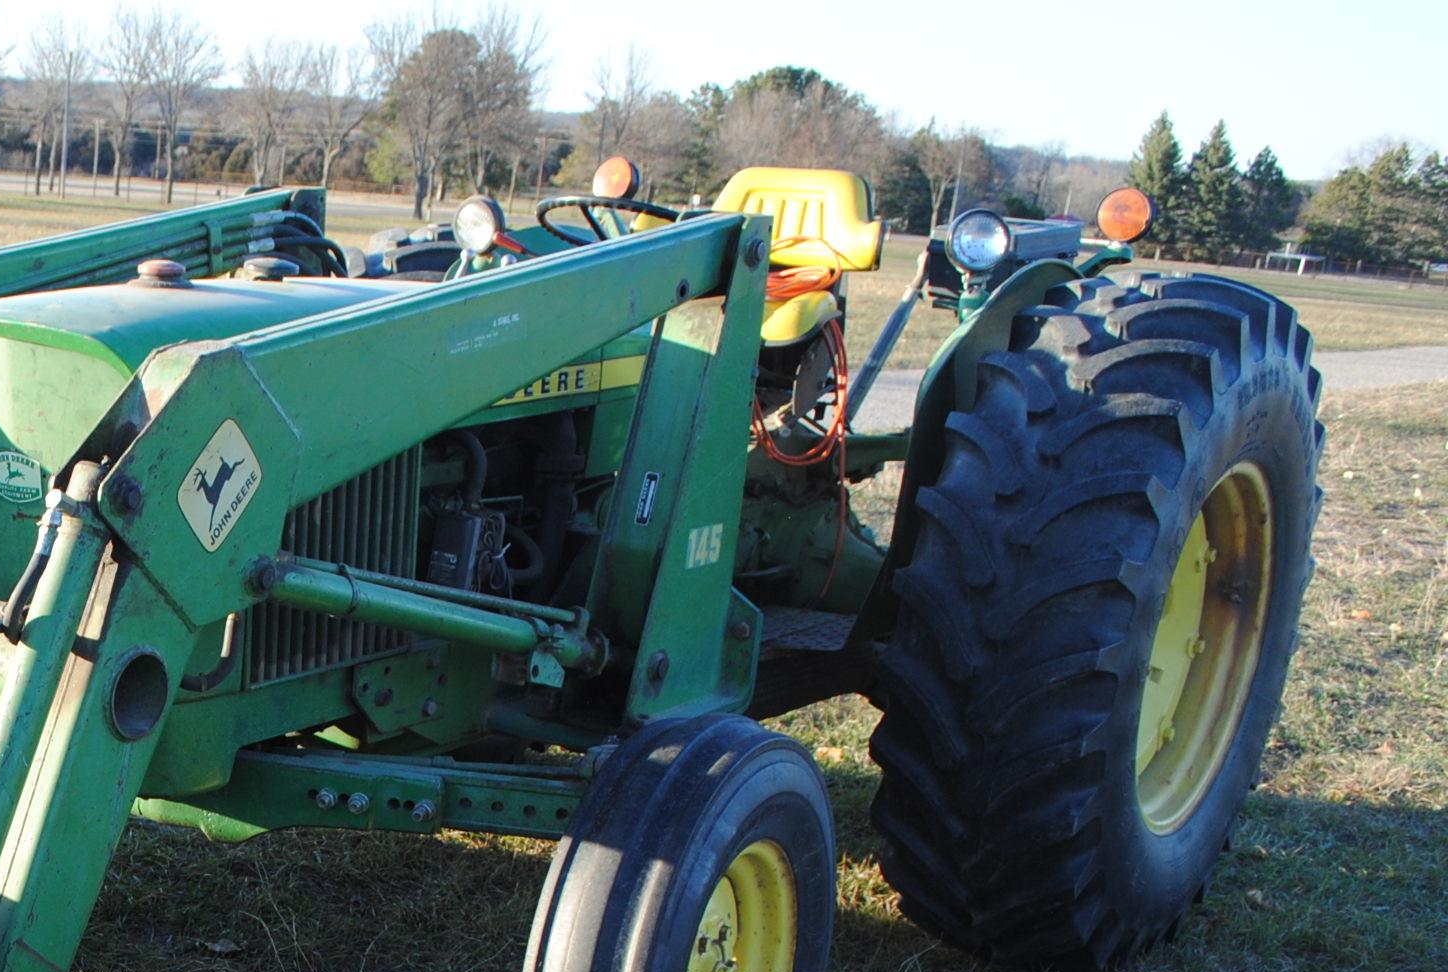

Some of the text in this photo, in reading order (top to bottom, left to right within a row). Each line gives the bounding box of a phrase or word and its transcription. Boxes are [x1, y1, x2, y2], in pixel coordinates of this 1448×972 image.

[210, 471, 257, 545] JOHN DEERE
[685, 524, 723, 569] 145
